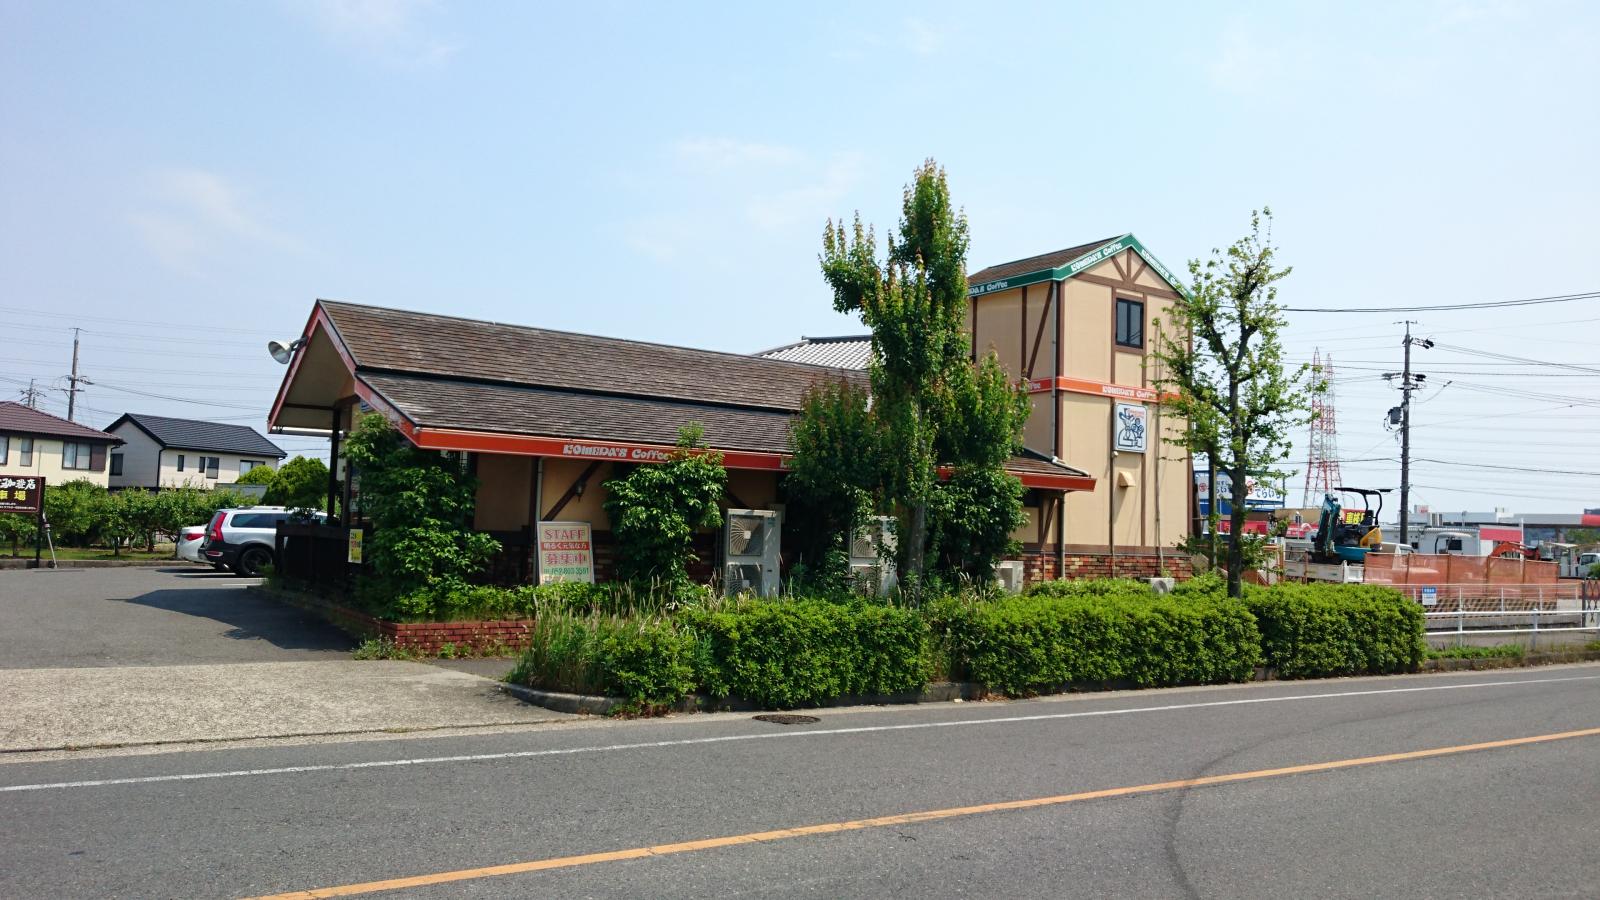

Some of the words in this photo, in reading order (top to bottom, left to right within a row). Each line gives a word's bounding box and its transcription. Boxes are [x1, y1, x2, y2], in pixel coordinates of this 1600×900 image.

[562, 444, 628, 458] KOMEDA'S
[631, 449, 669, 461] Coffee
[0, 478, 36, 490] 珈琲店
[544, 529, 585, 540] STAFF
